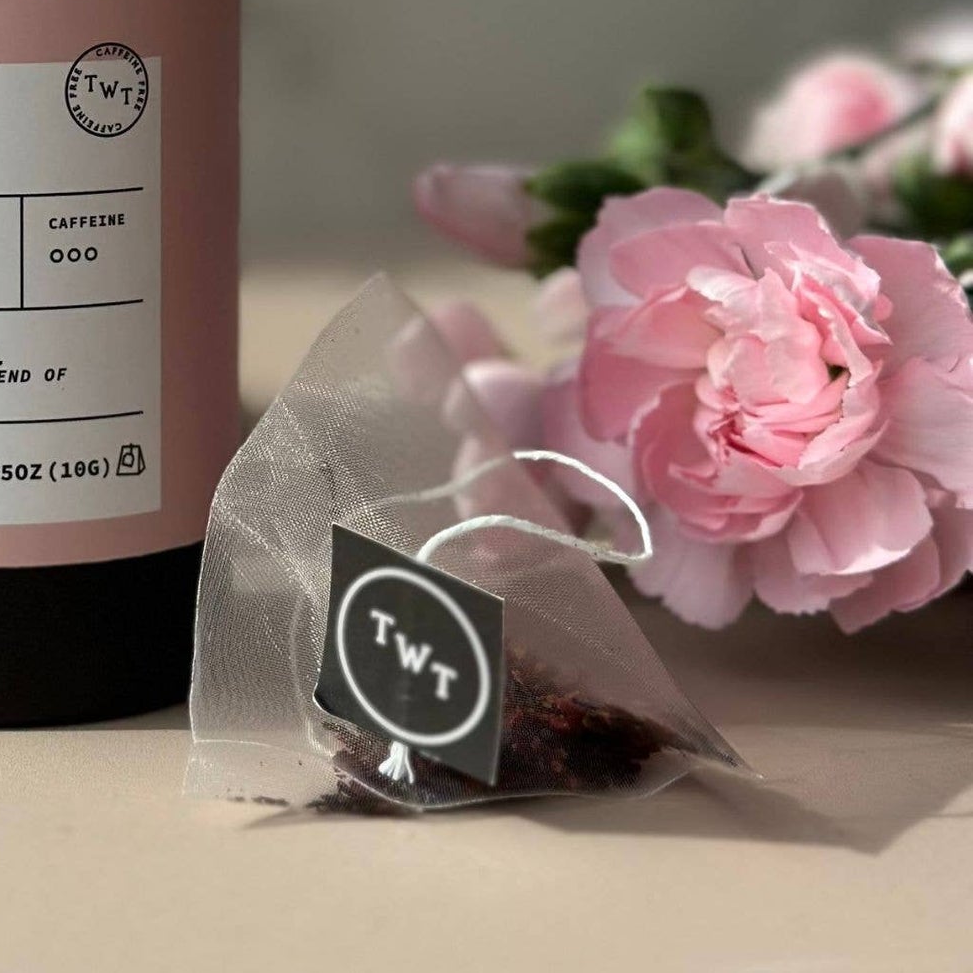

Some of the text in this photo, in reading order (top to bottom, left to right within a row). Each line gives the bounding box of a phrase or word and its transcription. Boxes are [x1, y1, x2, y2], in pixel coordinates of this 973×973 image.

[70, 67, 122, 132] CAFFEINE FREE
[84, 75, 133, 105] TWT
[96, 47, 145, 111] CAFFEINE FREE
[49, 213, 125, 230] CAFFEINE
[44, 367, 68, 382] OF
[370, 609, 458, 701] TWT
